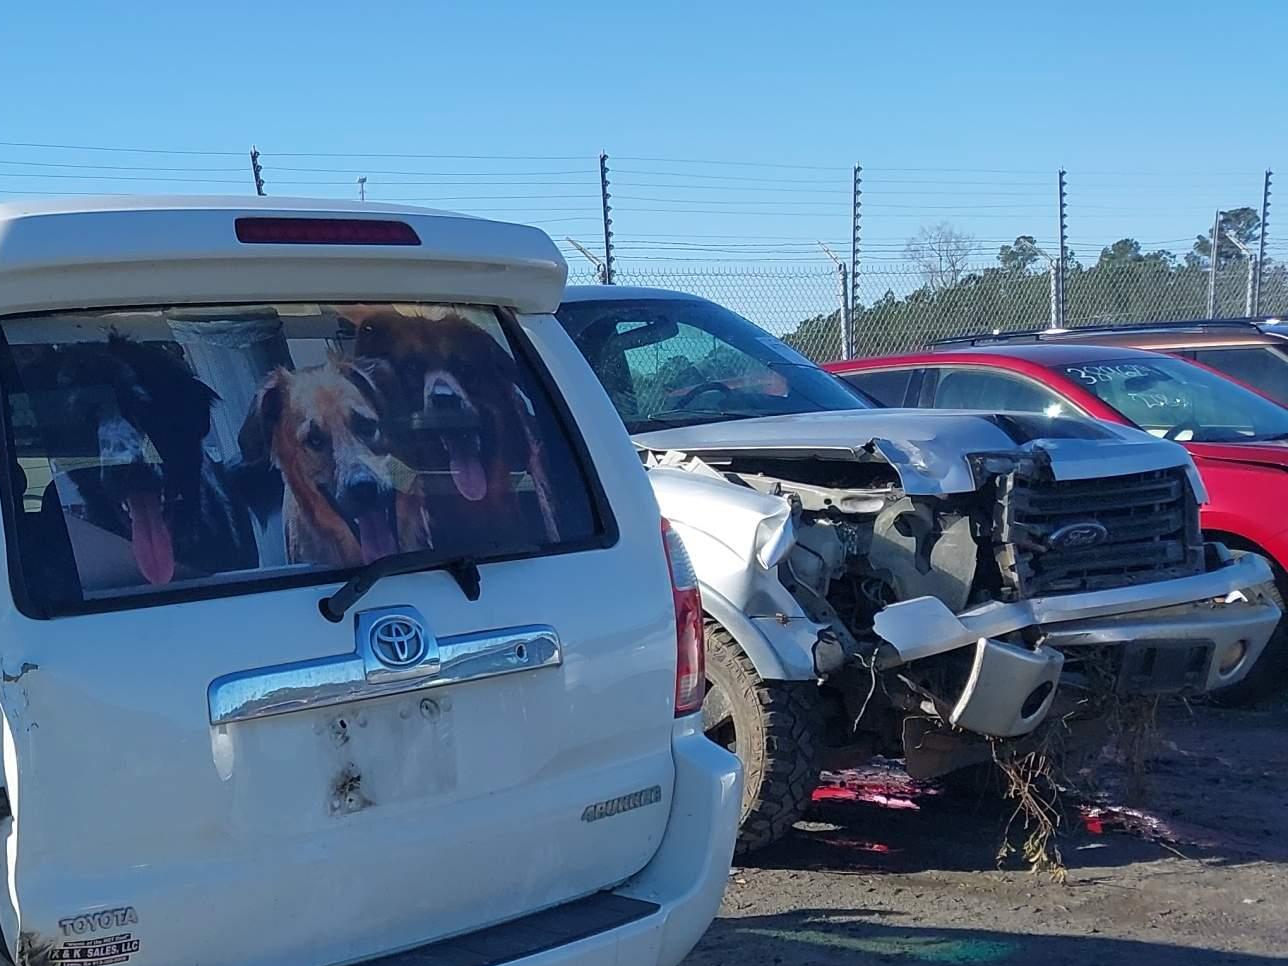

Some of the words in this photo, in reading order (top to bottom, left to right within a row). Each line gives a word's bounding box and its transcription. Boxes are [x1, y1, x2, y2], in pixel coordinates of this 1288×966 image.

[59, 906, 138, 937] TOYOTA
[73, 948, 82, 959] K
[87, 943, 120, 959] SALES,
[121, 940, 139, 953] LLC
